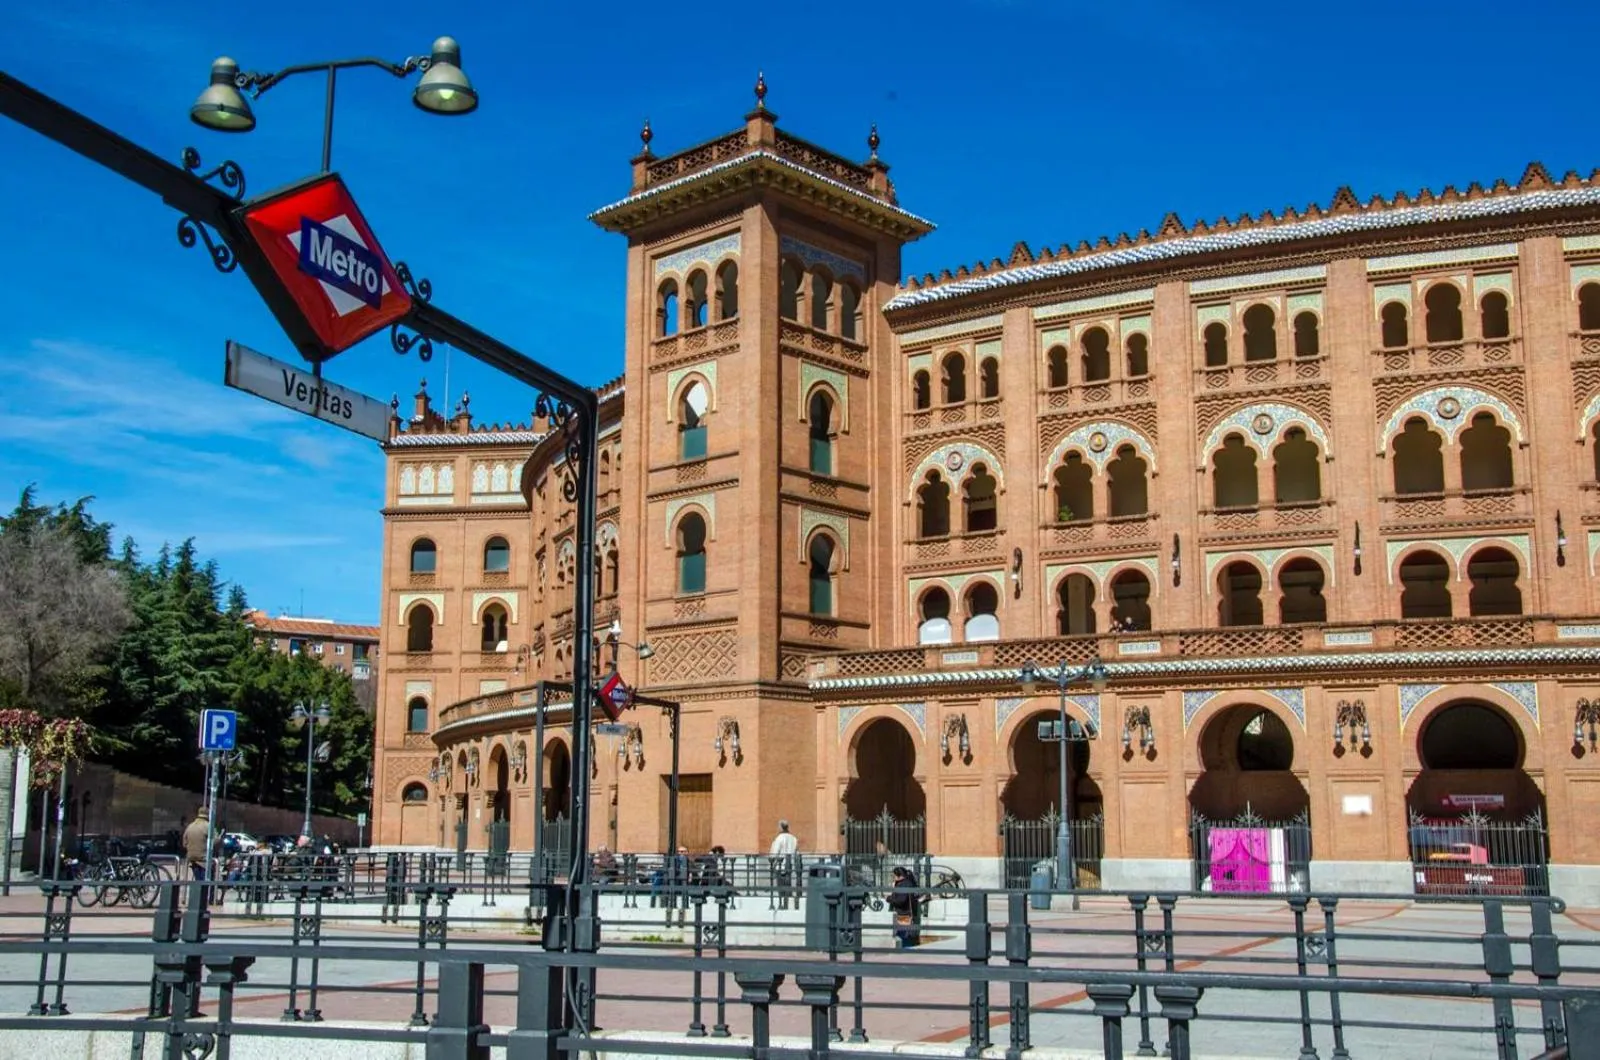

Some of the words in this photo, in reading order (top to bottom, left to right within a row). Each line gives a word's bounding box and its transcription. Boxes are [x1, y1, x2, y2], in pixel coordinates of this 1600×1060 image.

[309, 227, 379, 294] Metro
[282, 368, 353, 420] Ventas
[211, 714, 230, 744] P
